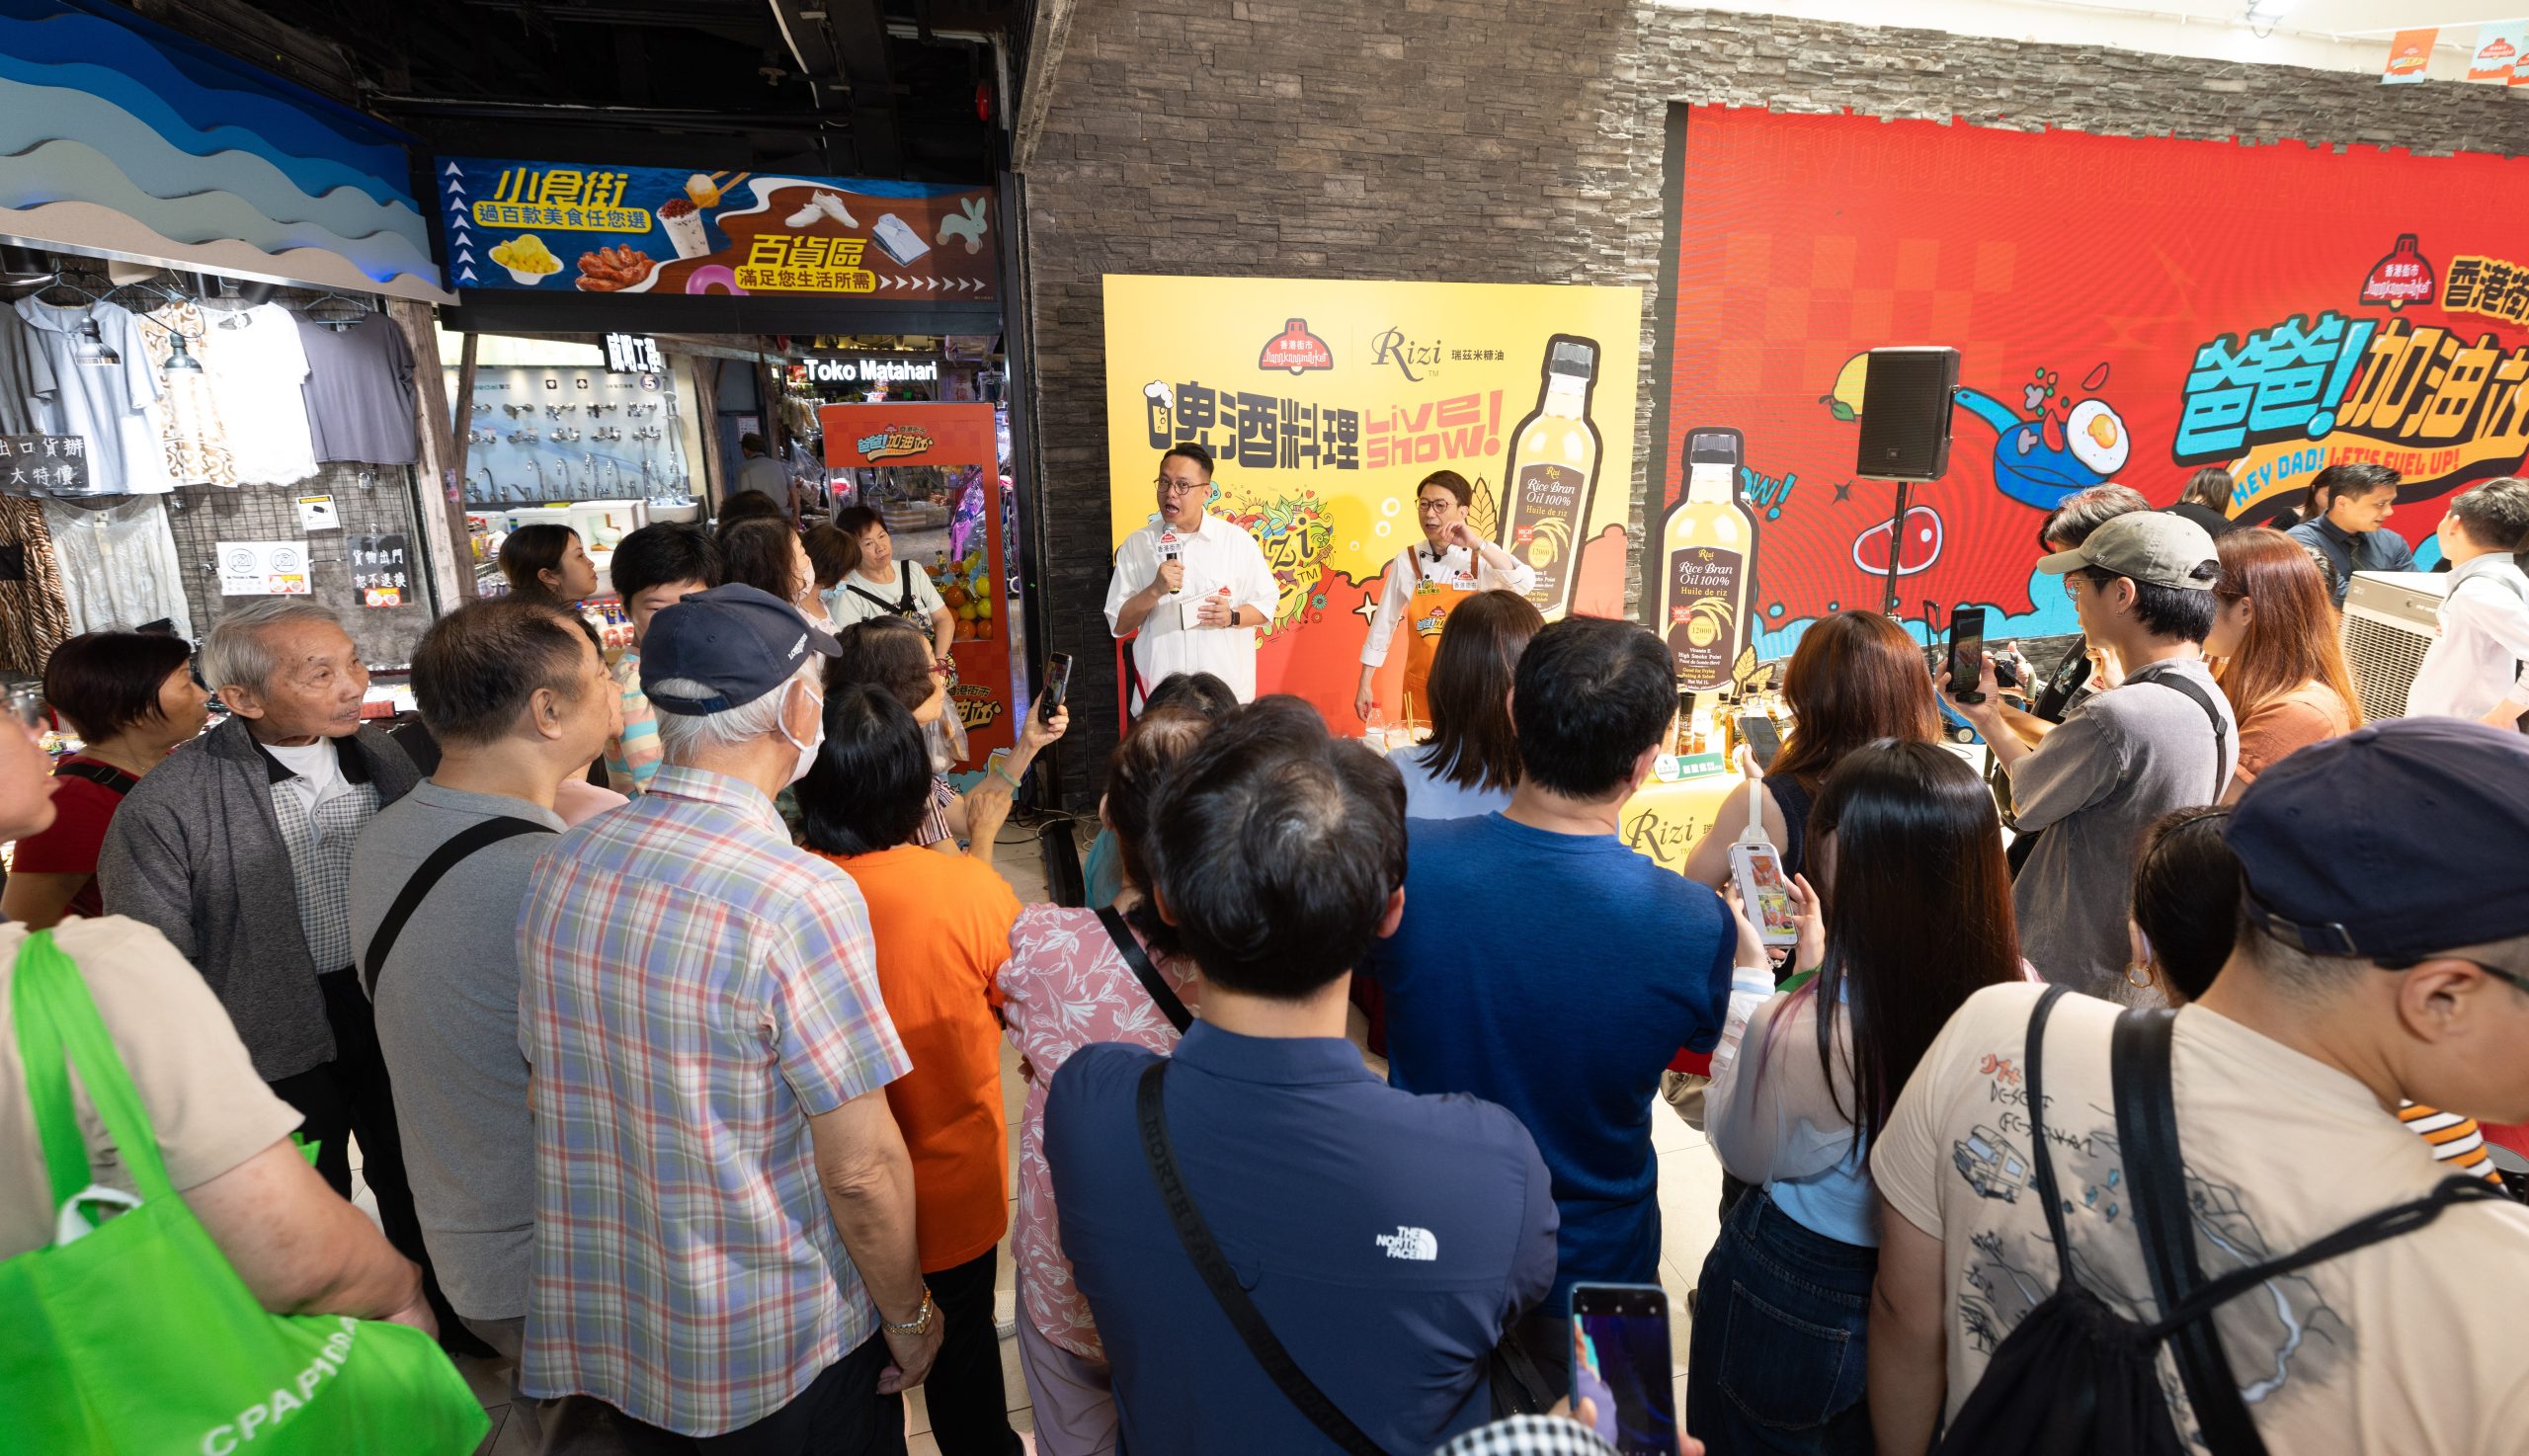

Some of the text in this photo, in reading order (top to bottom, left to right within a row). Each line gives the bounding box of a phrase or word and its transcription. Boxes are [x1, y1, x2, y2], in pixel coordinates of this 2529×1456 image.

[494, 167, 628, 207] 小食街
[478, 204, 646, 229] 過百款美食任您選
[747, 234, 867, 270] 百貨區
[740, 269, 870, 289] 滿足您生活所需
[1280, 340, 1313, 350] 香港街市
[1370, 325, 1441, 382] Rizi
[804, 360, 937, 381] Toko Matahari
[11, 465, 76, 486] 大特價
[2232, 462, 2272, 507] HEY
[2277, 446, 2325, 480] DAD!
[2429, 447, 2461, 475] UP!
[1527, 478, 1576, 494] Rice Bran
[1526, 491, 1571, 506] Oil 100%
[1297, 568, 1319, 583] TM
[1679, 561, 1733, 574] Rice Bran
[1680, 574, 1730, 586] Oil 100%
[1681, 587, 1702, 596] Huile
[1626, 808, 1694, 862] Rizi
[1397, 1226, 1420, 1239] THE
[1375, 1234, 1419, 1249] NORTH
[1386, 1247, 1417, 1259] FACE
